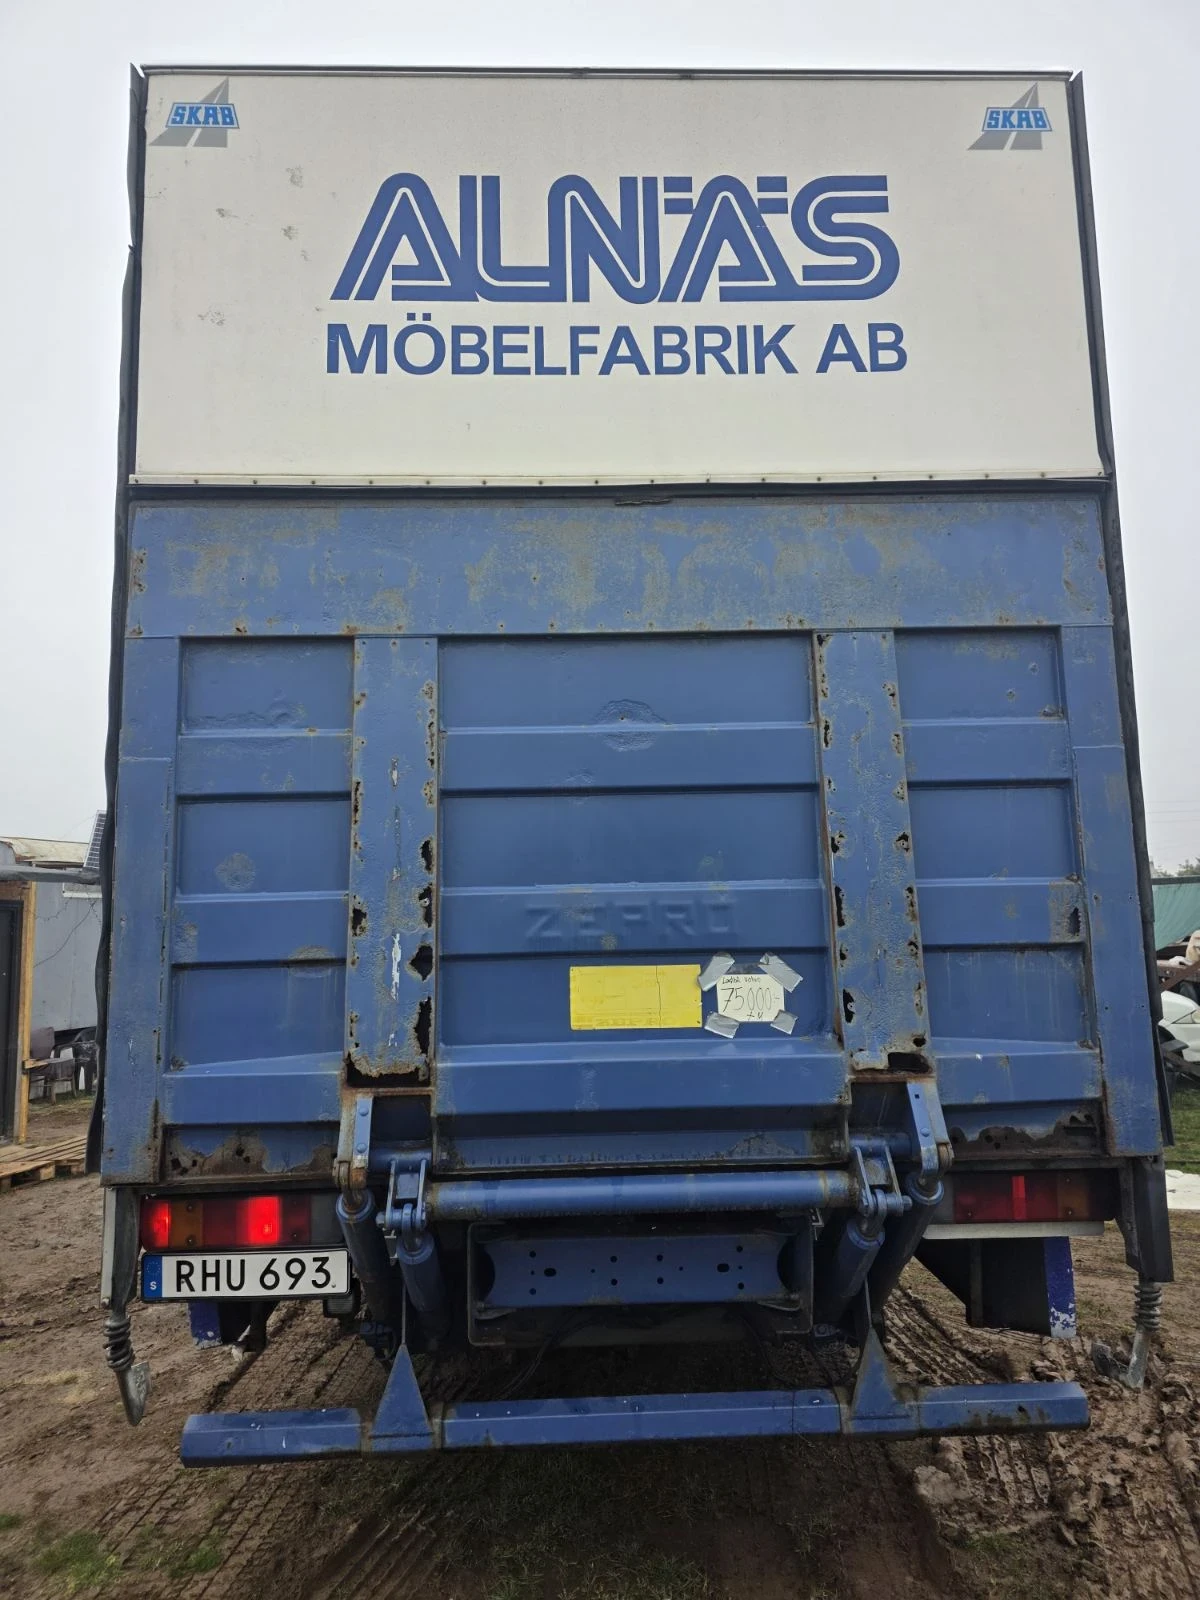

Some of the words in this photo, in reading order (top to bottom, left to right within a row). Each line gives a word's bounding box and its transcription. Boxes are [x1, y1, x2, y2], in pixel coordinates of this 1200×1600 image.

[170, 105, 235, 126] SKAB
[986, 109, 1048, 129] SKAB
[326, 312, 799, 376] MÖBELFABRIK
[815, 322, 908, 373] AB
[175, 1259, 246, 1293] RHU
[259, 1256, 331, 1291] 693
[149, 1281, 158, 1291] S
